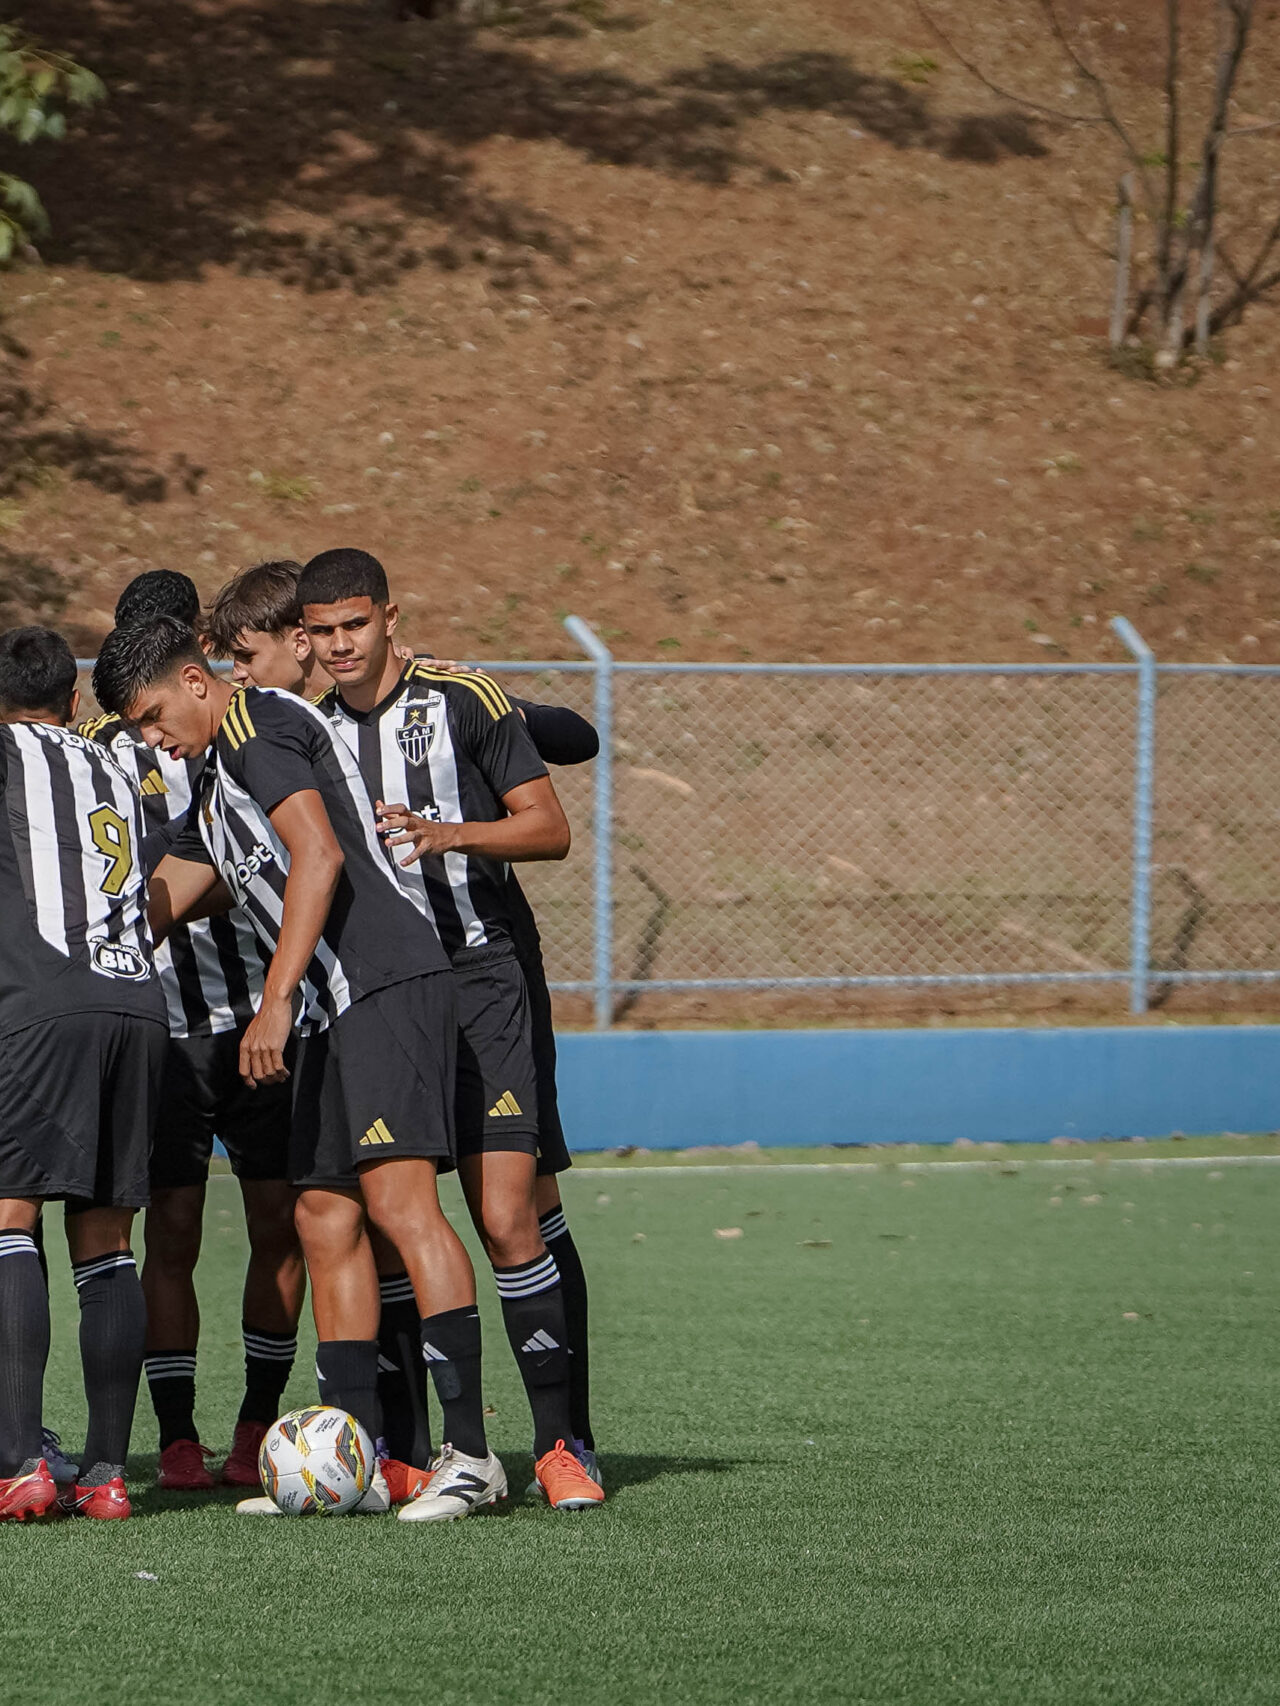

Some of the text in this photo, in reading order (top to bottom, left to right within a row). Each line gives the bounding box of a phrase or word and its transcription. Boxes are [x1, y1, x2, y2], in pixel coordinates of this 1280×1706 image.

[402, 726, 431, 739] CAM
[87, 805, 133, 896] 9
[100, 948, 136, 973] BH
